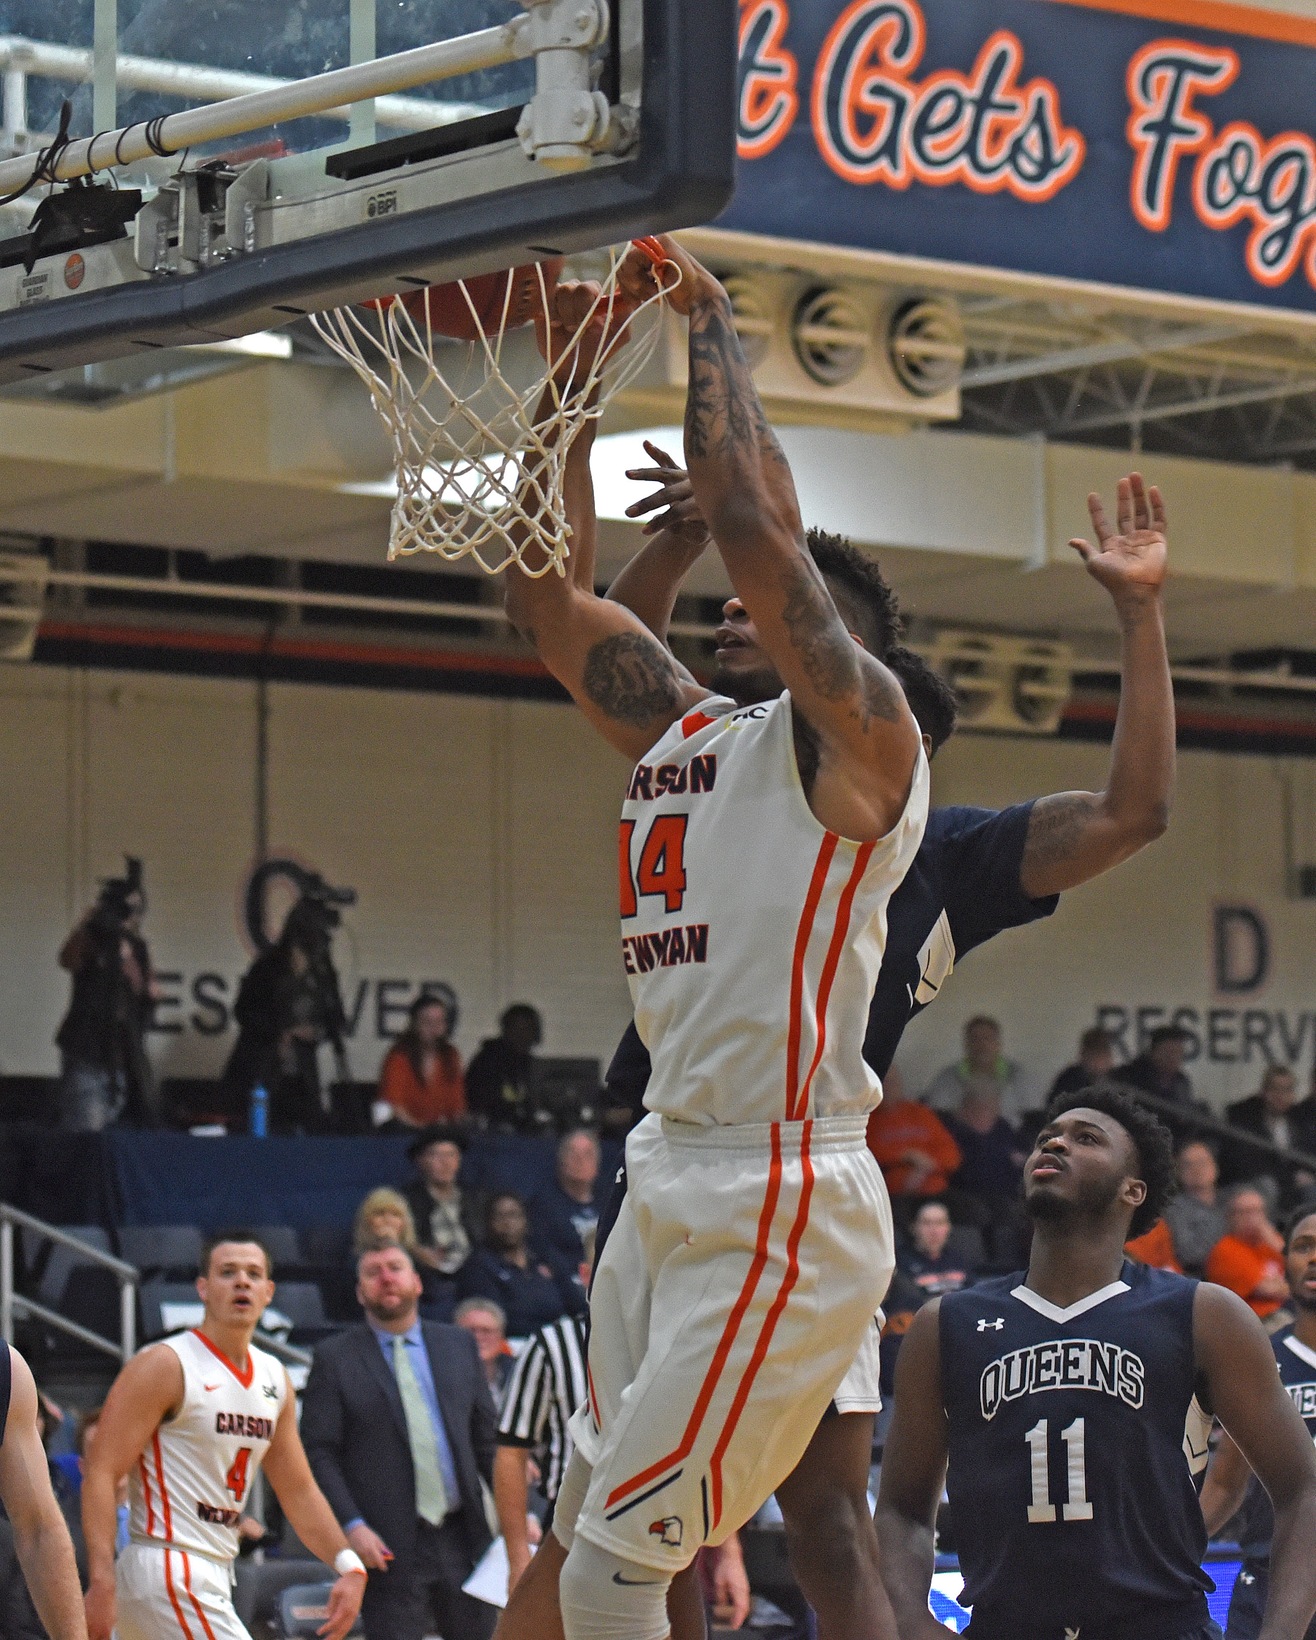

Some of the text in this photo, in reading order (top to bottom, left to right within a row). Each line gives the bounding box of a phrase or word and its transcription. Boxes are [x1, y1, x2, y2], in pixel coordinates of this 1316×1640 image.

[815, 0, 1081, 196] Gets
[1130, 42, 1316, 285] Fog
[626, 754, 717, 801] RSON
[618, 813, 690, 920] 14
[1213, 904, 1272, 993] D
[1097, 1005, 1316, 1065] RESERV
[979, 1337, 1146, 1422] QUEENS
[215, 1411, 273, 1441] CARSON
[226, 1446, 252, 1503] 4
[1023, 1416, 1094, 1525] 11
